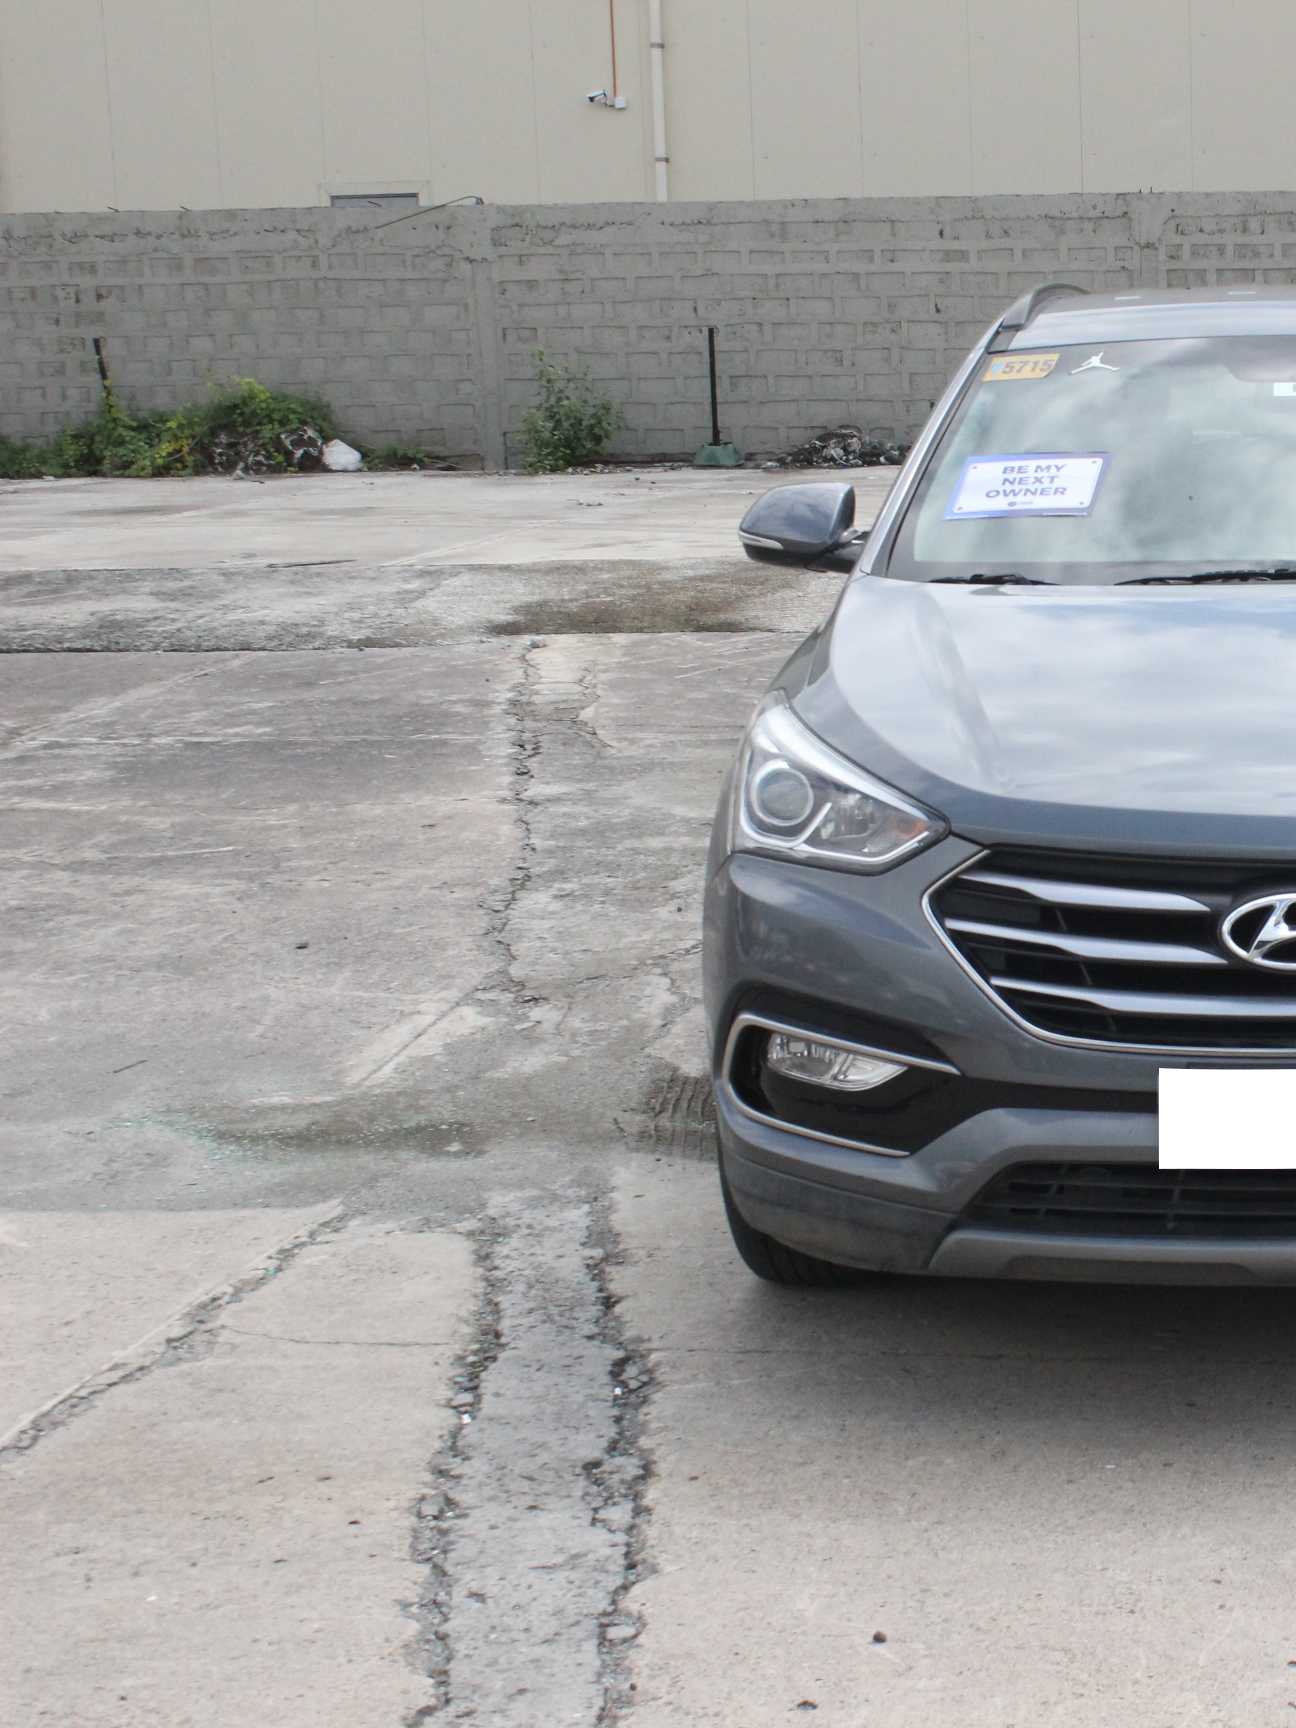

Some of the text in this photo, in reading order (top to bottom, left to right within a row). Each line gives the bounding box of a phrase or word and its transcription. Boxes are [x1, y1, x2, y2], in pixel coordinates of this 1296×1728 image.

[1002, 463, 1067, 474] BE MY
[1001, 475, 1059, 486] NEXT
[984, 487, 1068, 498] OWNER
